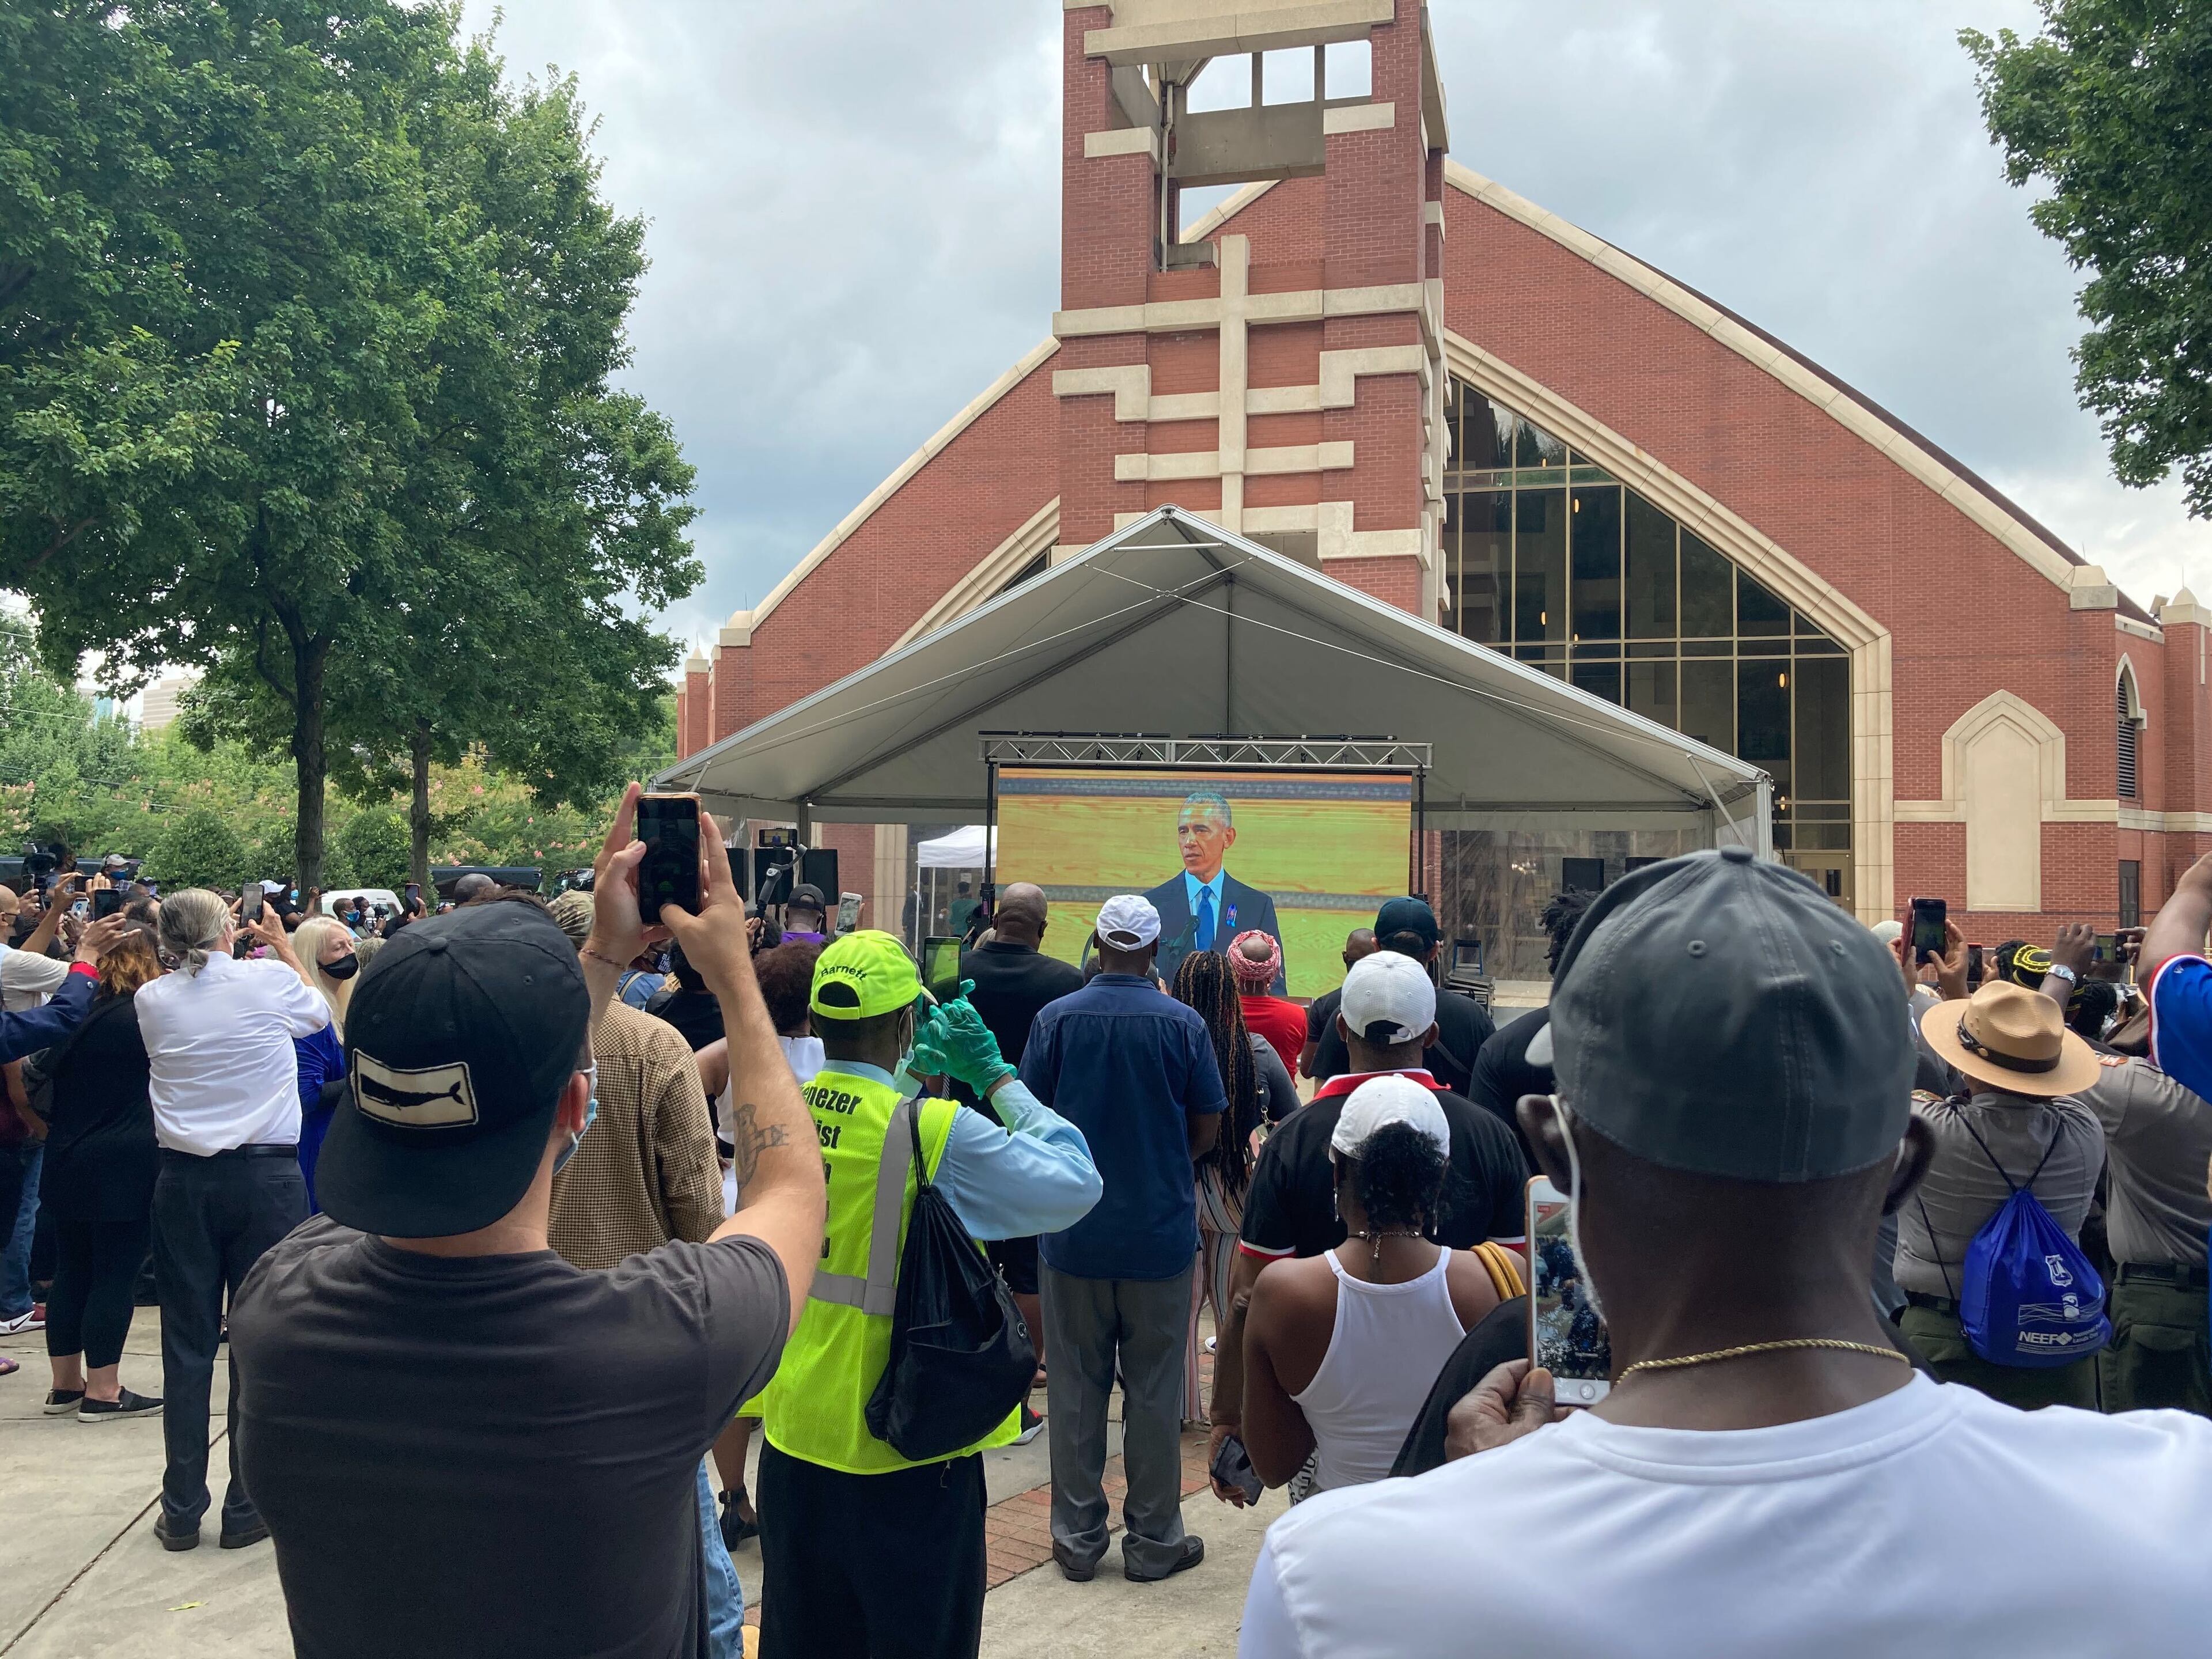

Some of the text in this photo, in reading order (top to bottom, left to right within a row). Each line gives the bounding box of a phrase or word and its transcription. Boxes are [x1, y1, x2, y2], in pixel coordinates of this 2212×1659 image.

[821, 965, 868, 981] Barnett
[801, 1086, 863, 1115] enezer
[815, 1119, 842, 1149] ist
[2018, 1331, 2059, 1344] NEEF
